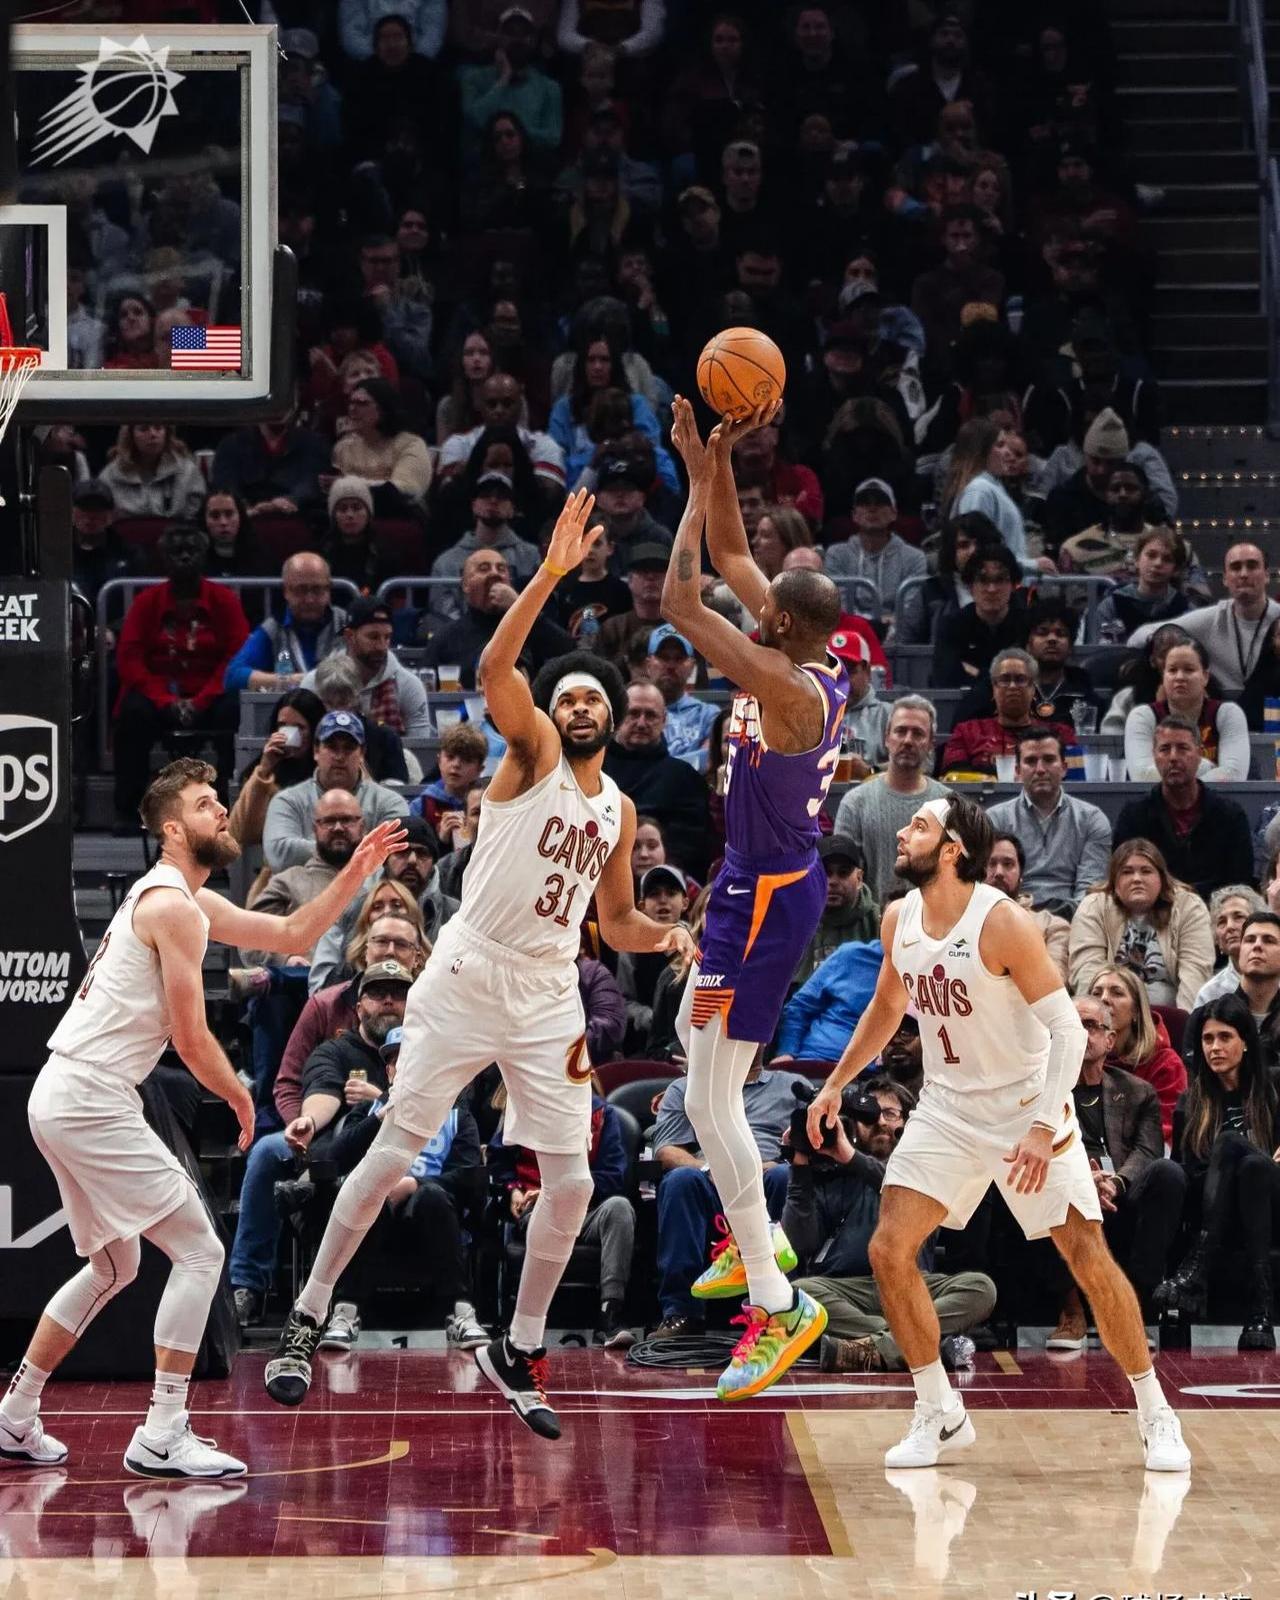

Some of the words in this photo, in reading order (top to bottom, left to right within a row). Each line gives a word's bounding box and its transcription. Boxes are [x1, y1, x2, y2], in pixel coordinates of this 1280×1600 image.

[537, 815, 610, 882] CAVS
[534, 872, 581, 928] 31
[902, 971, 973, 1016] CAVS
[937, 1023, 961, 1065] 1
